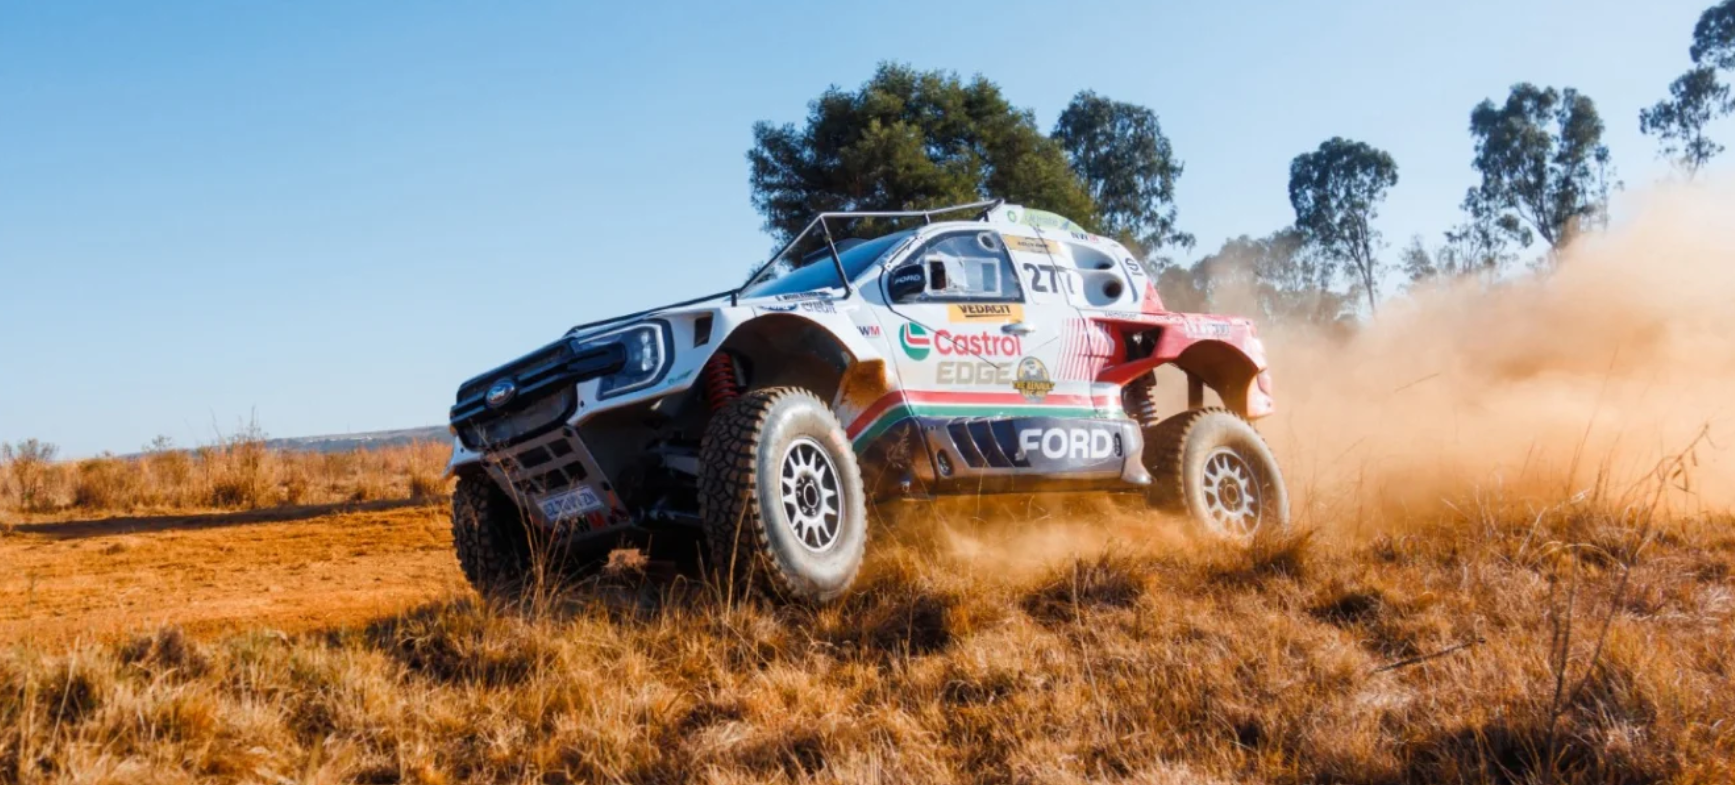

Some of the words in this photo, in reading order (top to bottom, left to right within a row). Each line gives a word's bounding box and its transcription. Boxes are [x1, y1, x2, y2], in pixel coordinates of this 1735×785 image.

[1023, 263, 1074, 294] 277
[957, 304, 1011, 314] VEDACIT
[857, 325, 880, 336] WM
[934, 329, 1022, 356] Castrol
[936, 361, 1013, 385] EDGE
[1016, 427, 1113, 460] FORD
